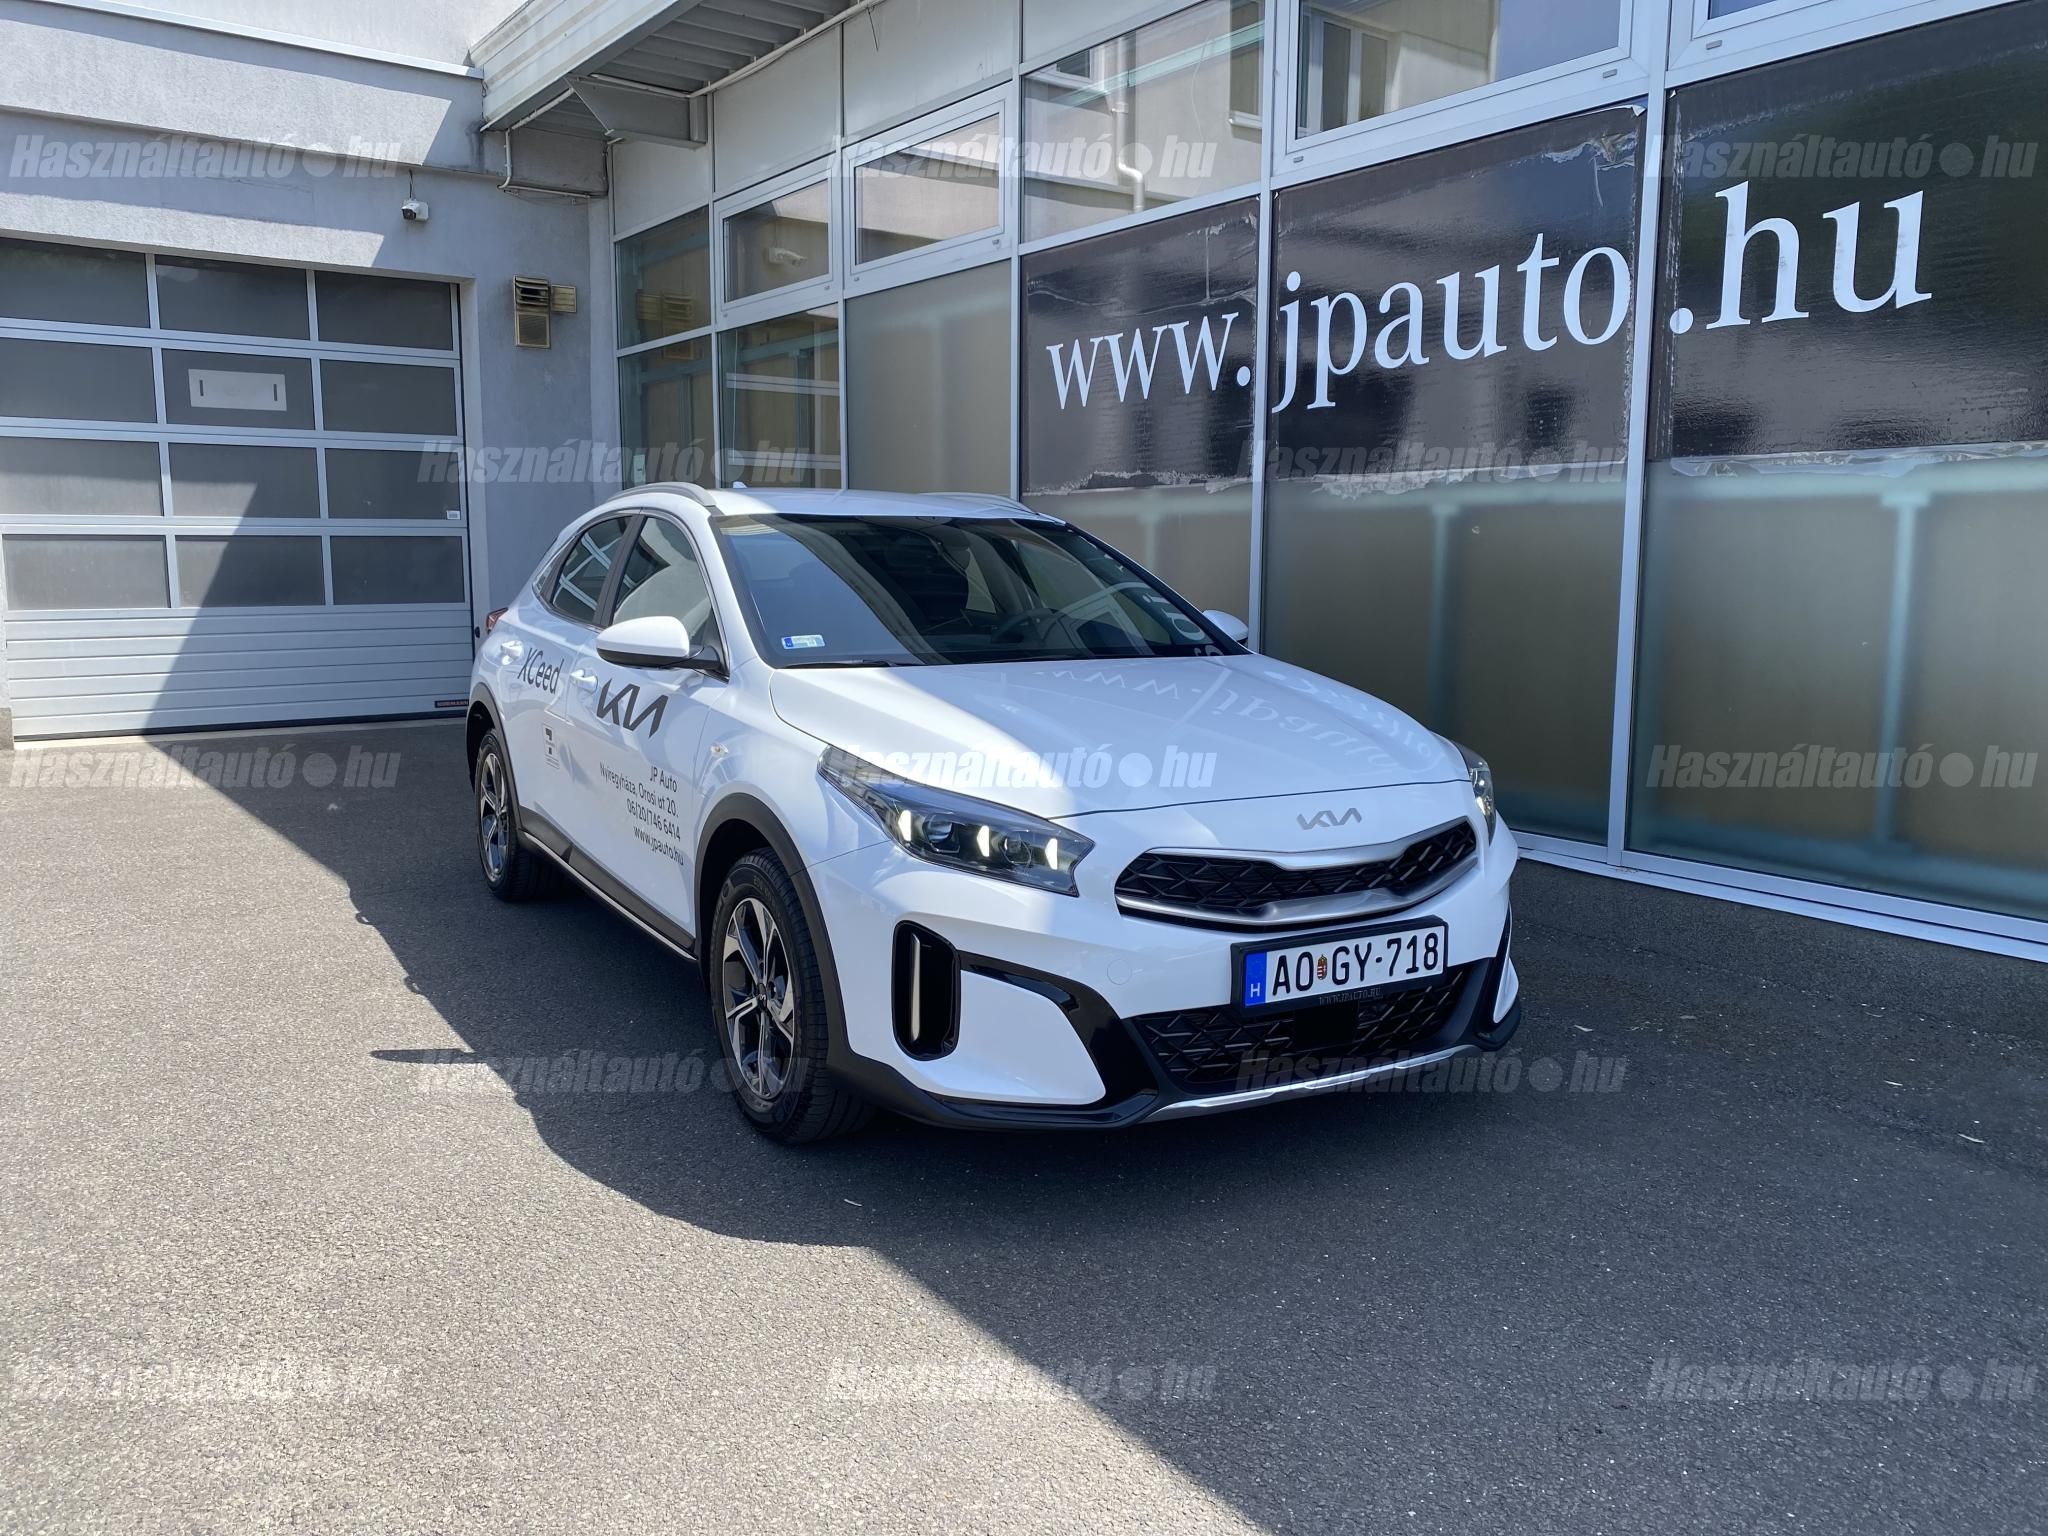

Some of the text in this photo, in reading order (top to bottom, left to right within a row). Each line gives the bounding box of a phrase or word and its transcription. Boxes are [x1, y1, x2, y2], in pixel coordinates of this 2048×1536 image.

[1046, 181, 1932, 410] www.jpauto.hu
[518, 647, 564, 696] XCeed
[649, 766, 677, 792] JP Auto
[1250, 983, 1261, 999] H
